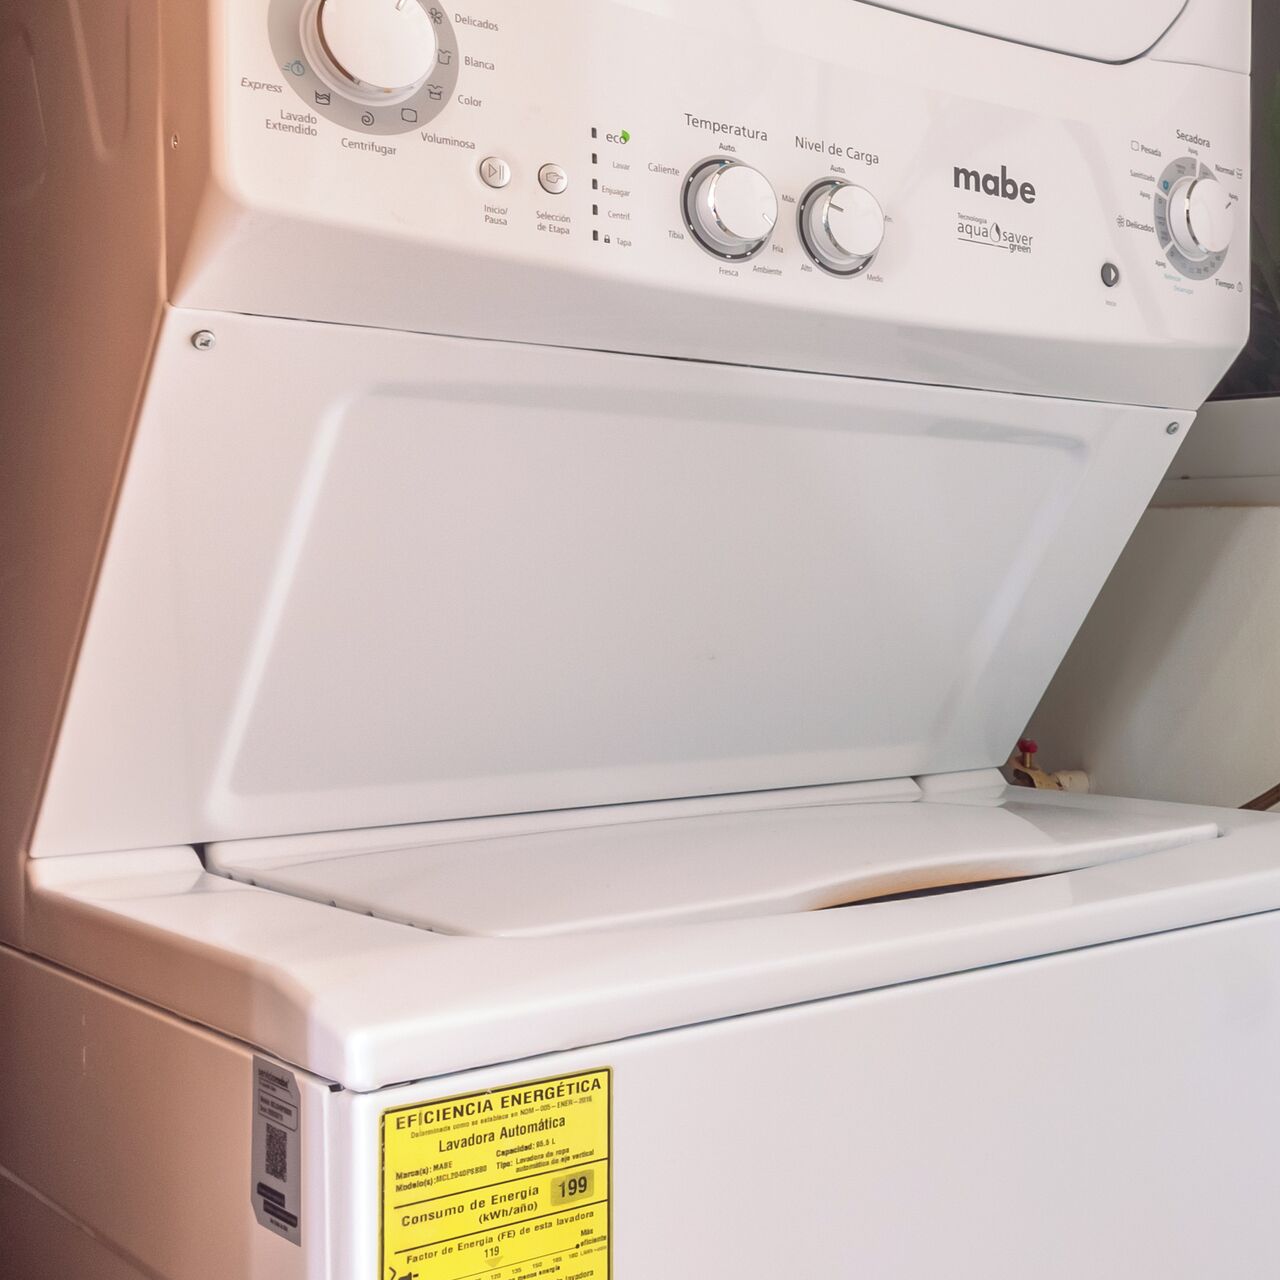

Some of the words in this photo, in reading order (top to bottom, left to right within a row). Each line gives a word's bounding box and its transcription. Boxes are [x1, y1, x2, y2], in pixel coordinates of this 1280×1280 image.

[455, 14, 499, 32] Delicados
[464, 56, 495, 71] Blanca
[241, 77, 283, 94] Express
[458, 95, 482, 108] Color
[280, 109, 317, 125] Lavado
[265, 119, 318, 137] Extendido
[684, 113, 768, 142] Temperatura
[421, 132, 476, 150] Voluminosa
[606, 131, 627, 145] eco
[1176, 129, 1211, 148] Secadora
[341, 138, 397, 156] Centrifugar
[795, 136, 825, 154] Nivel
[828, 142, 842, 156] de
[846, 147, 879, 165] Carga
[648, 162, 680, 177] Caliente
[601, 184, 631, 198] Enjuagar
[953, 165, 1036, 204] mabe
[484, 214, 508, 226] Pausa
[536, 210, 571, 225] Selección
[537, 222, 547, 232] de
[548, 223, 571, 236] Etapa
[957, 221, 989, 240] aqua
[1002, 230, 1033, 247] saver
[1125, 218, 1155, 234] Delicados
[616, 236, 632, 248] Tapa
[668, 229, 685, 241] Tibia
[1009, 242, 1031, 254] green
[719, 267, 739, 278] Fresca
[395, 1098, 493, 1130] EFICIENCIA
[500, 1077, 601, 1109] ENERGÉTICA
[439, 1128, 495, 1152] Lavadora
[499, 1113, 565, 1139] Automática
[433, 1160, 452, 1171] MABE
[496, 1158, 512, 1170] Tipo:
[401, 1202, 464, 1228] Consumo
[470, 1197, 485, 1211] de
[491, 1184, 539, 1207] Energía
[558, 1175, 587, 1199] 199
[478, 1200, 537, 1225] (kWh/año)
[406, 1248, 438, 1265] Factor
[441, 1244, 452, 1256] de
[457, 1234, 493, 1253] Energía
[497, 1228, 515, 1242] (FE)
[519, 1224, 530, 1236] de
[534, 1219, 552, 1232] esta
[556, 1209, 594, 1226] lavadora
[484, 1245, 499, 1259] 119
